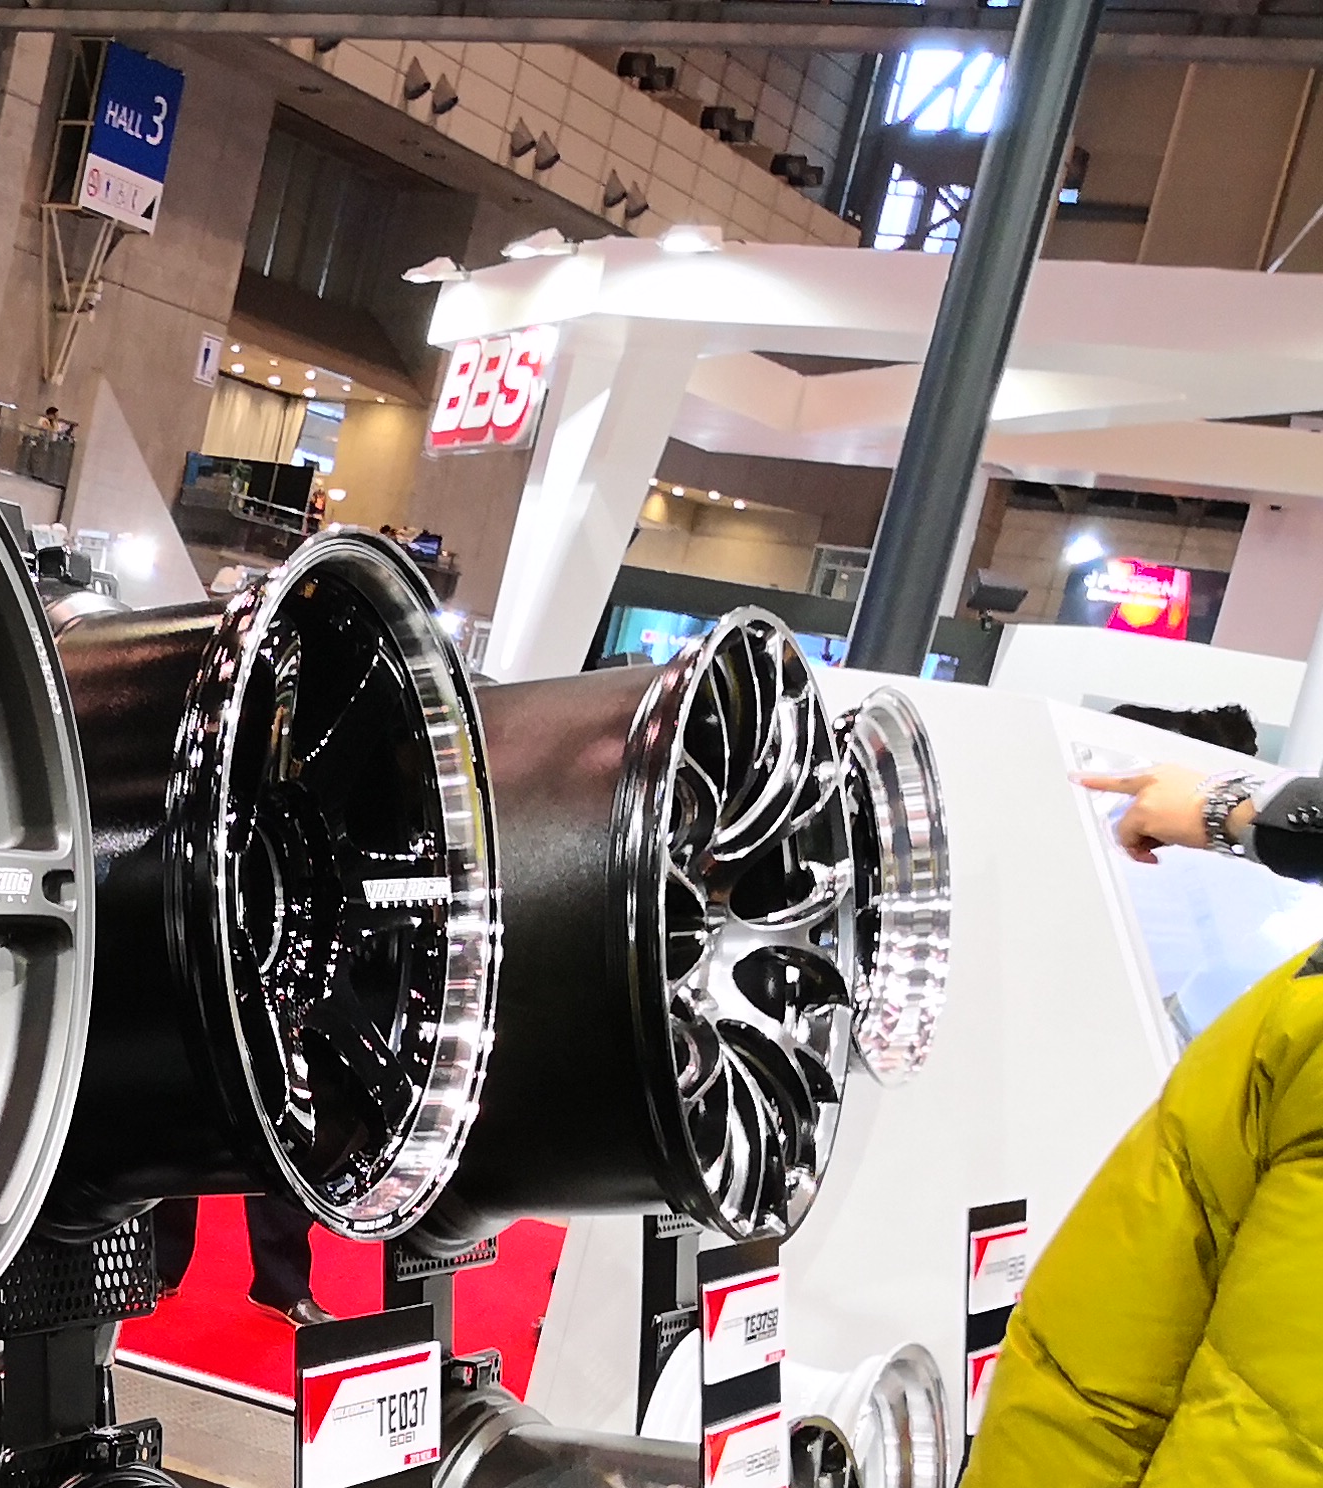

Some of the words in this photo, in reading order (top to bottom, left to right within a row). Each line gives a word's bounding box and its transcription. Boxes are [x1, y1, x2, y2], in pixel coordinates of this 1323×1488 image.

[105, 100, 143, 140] HALL
[145, 95, 168, 146] 3
[430, 327, 553, 446] BBS
[376, 1386, 428, 1437] TE037
